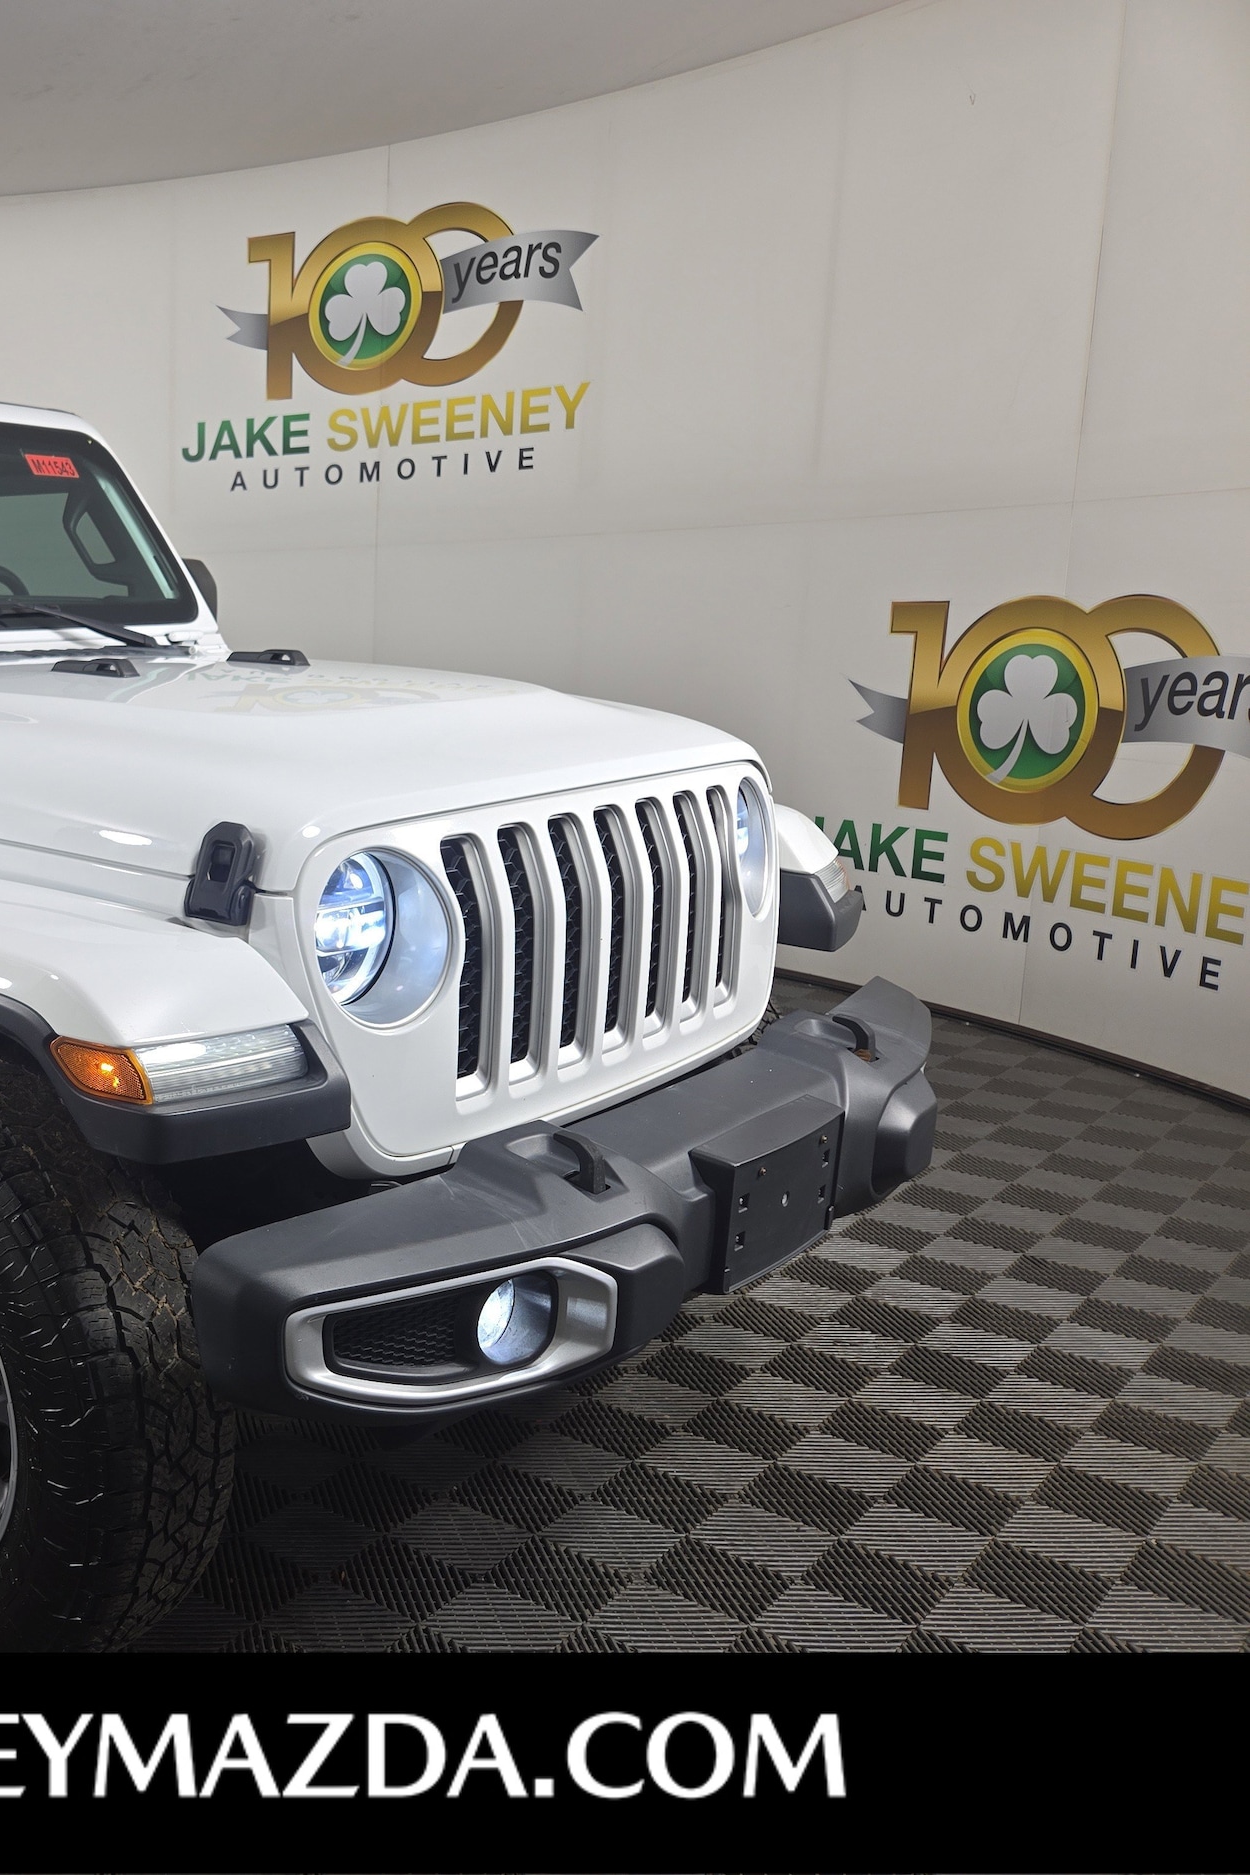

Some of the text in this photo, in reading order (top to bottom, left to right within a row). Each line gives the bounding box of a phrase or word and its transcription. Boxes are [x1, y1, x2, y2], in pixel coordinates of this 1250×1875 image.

[452, 240, 562, 302] years
[181, 381, 591, 463] JAKE SWEENEY
[31, 459, 75, 476] M11543
[230, 447, 534, 491] AUTOMOTIVE
[1134, 670, 1250, 731] year
[815, 816, 1250, 946] AKE SWEENE
